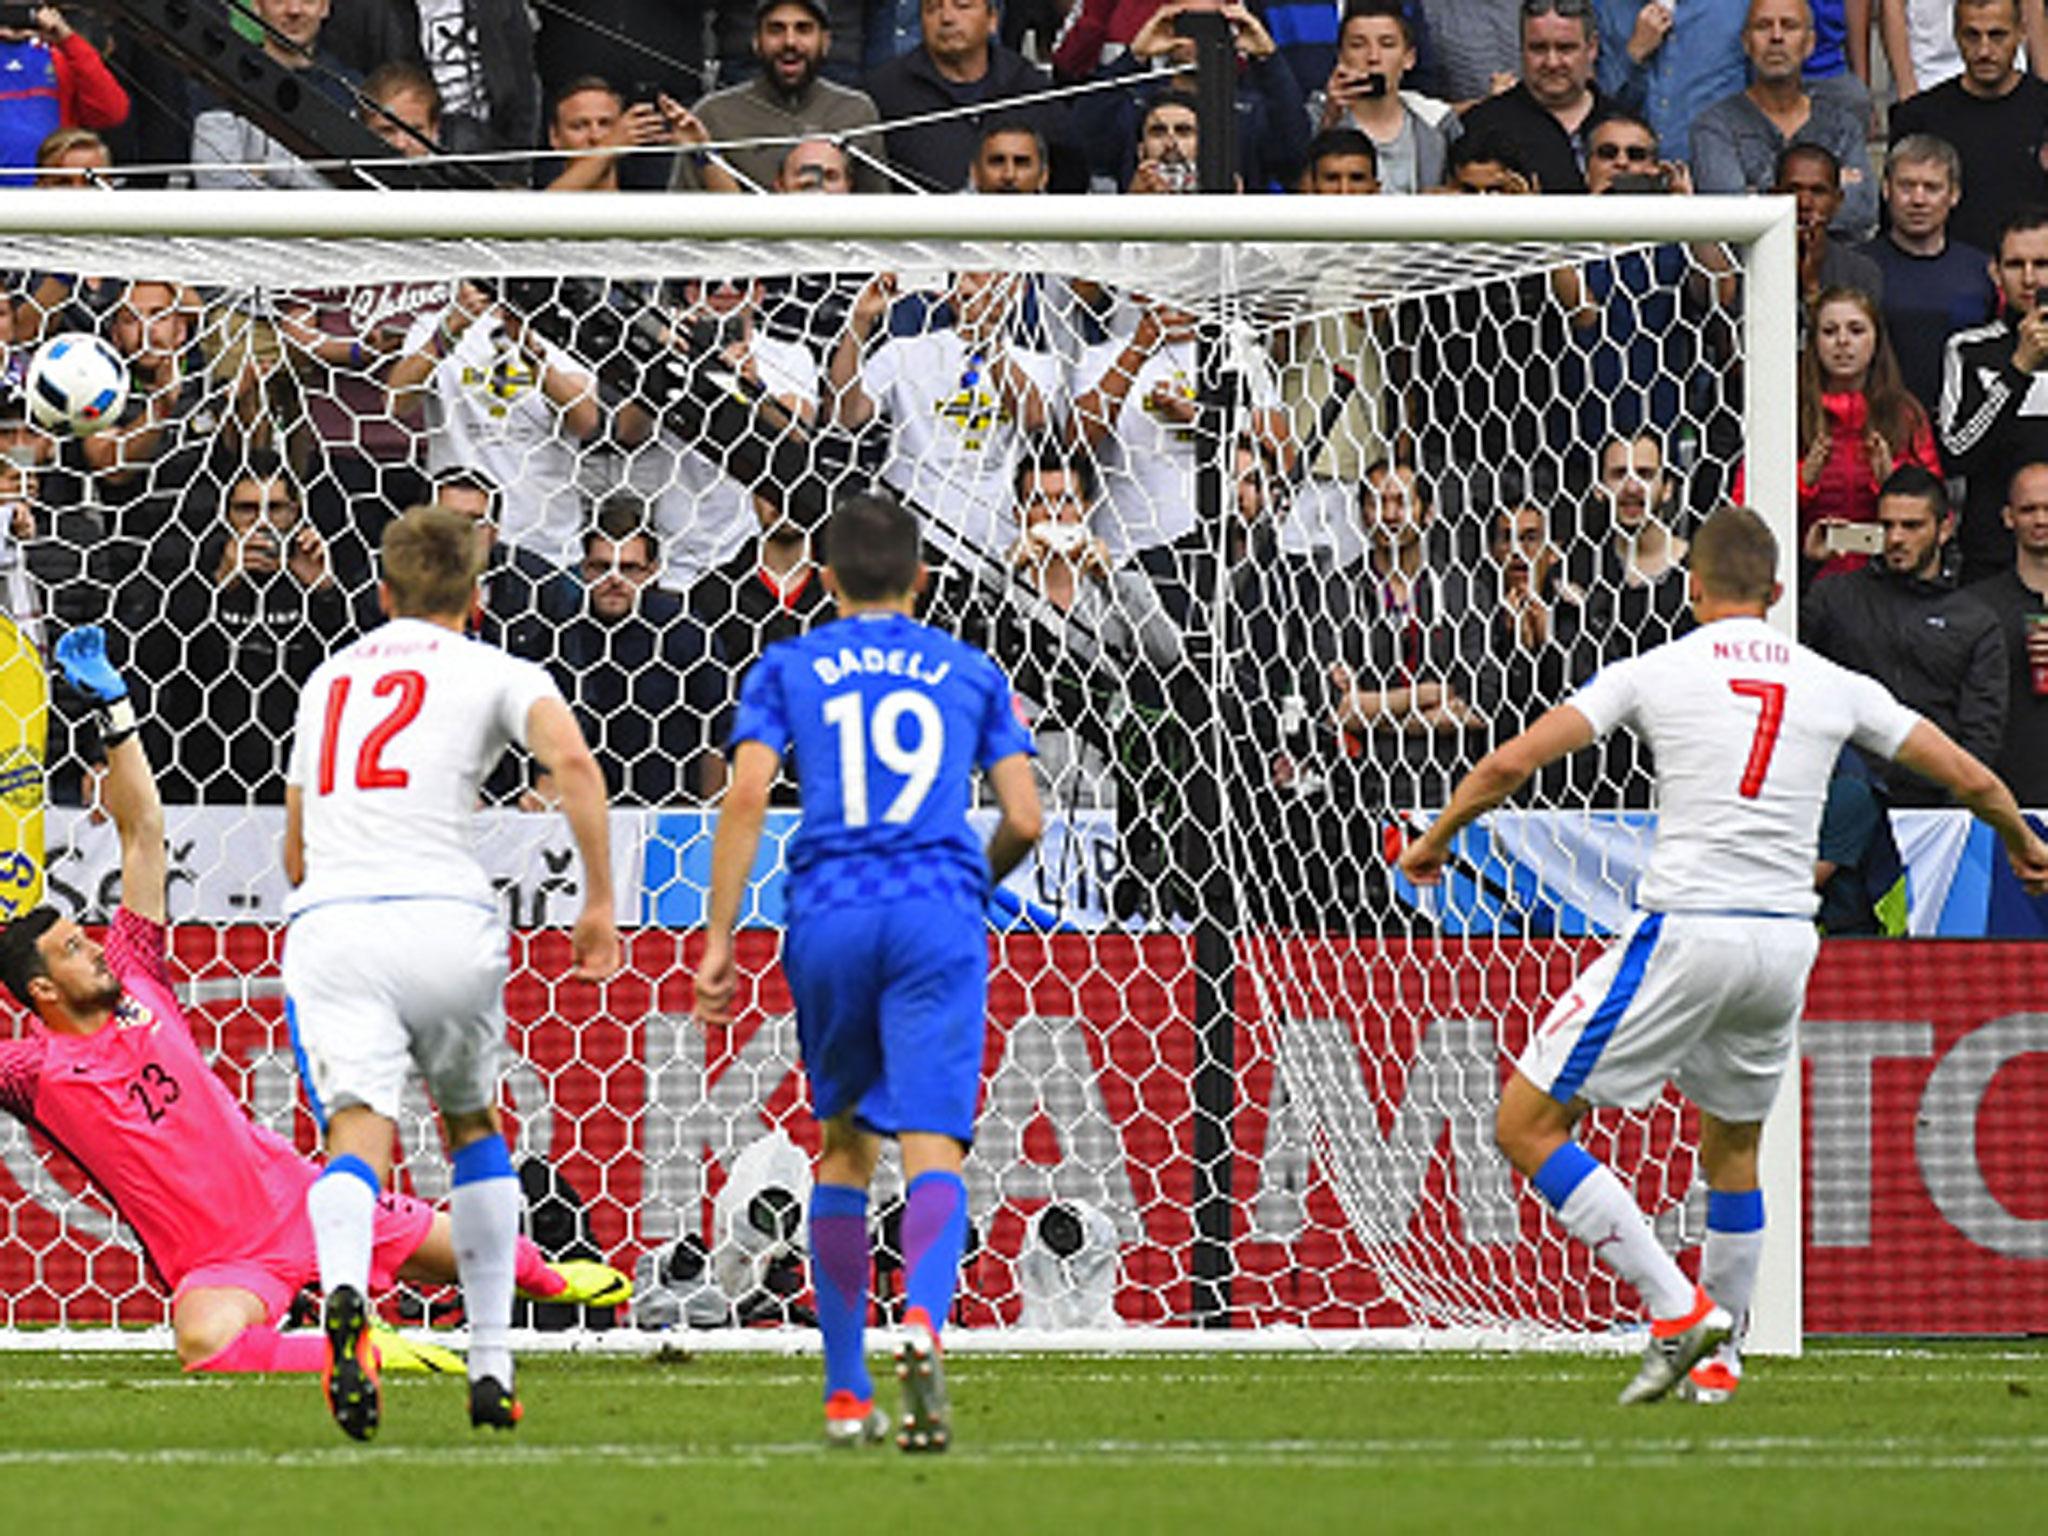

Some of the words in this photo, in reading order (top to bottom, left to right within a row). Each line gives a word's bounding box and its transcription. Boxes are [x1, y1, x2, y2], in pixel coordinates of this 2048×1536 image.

[813, 647, 951, 686] BADELJ
[318, 670, 427, 796] 12
[823, 687, 945, 829] 19
[1728, 679, 1787, 799] 7
[1546, 993, 1586, 1037] 7
[129, 1063, 180, 1123] 23
